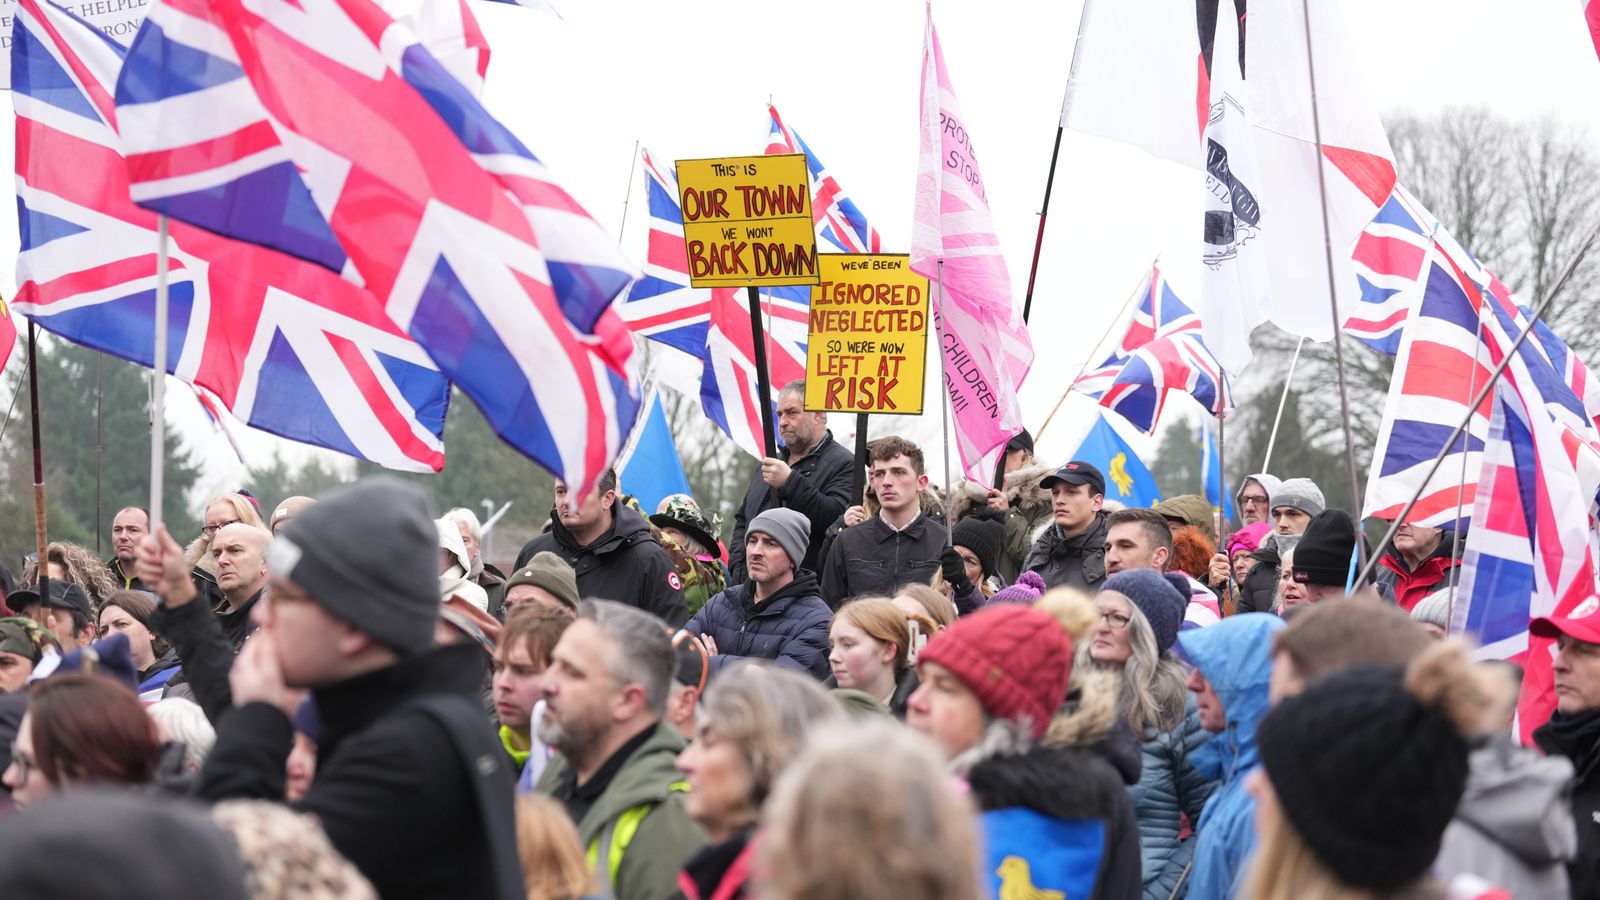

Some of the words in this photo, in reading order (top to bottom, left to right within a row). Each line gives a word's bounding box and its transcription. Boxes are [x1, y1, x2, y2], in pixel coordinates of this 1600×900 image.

[102, 18, 139, 37] RON
[711, 164, 737, 177] THIS
[744, 163, 757, 176] IS
[946, 150, 980, 187] STOP
[683, 186, 730, 221] OUR
[734, 184, 806, 218] TOWN
[722, 227, 737, 240] WE
[746, 227, 774, 239] WONT
[688, 240, 749, 278] BACK
[752, 243, 816, 277] DOWN
[840, 261, 869, 271] WEVE
[872, 260, 902, 270] BEEN
[815, 281, 921, 306] IGNORED
[810, 308, 924, 334] NEGLECTED
[826, 340, 842, 353] SO
[847, 340, 876, 354] WERE
[880, 342, 905, 354] NOW
[816, 353, 864, 377] LEFT
[877, 355, 906, 377] AT
[943, 333, 998, 419] CHILDREN
[825, 376, 899, 410] RISK
